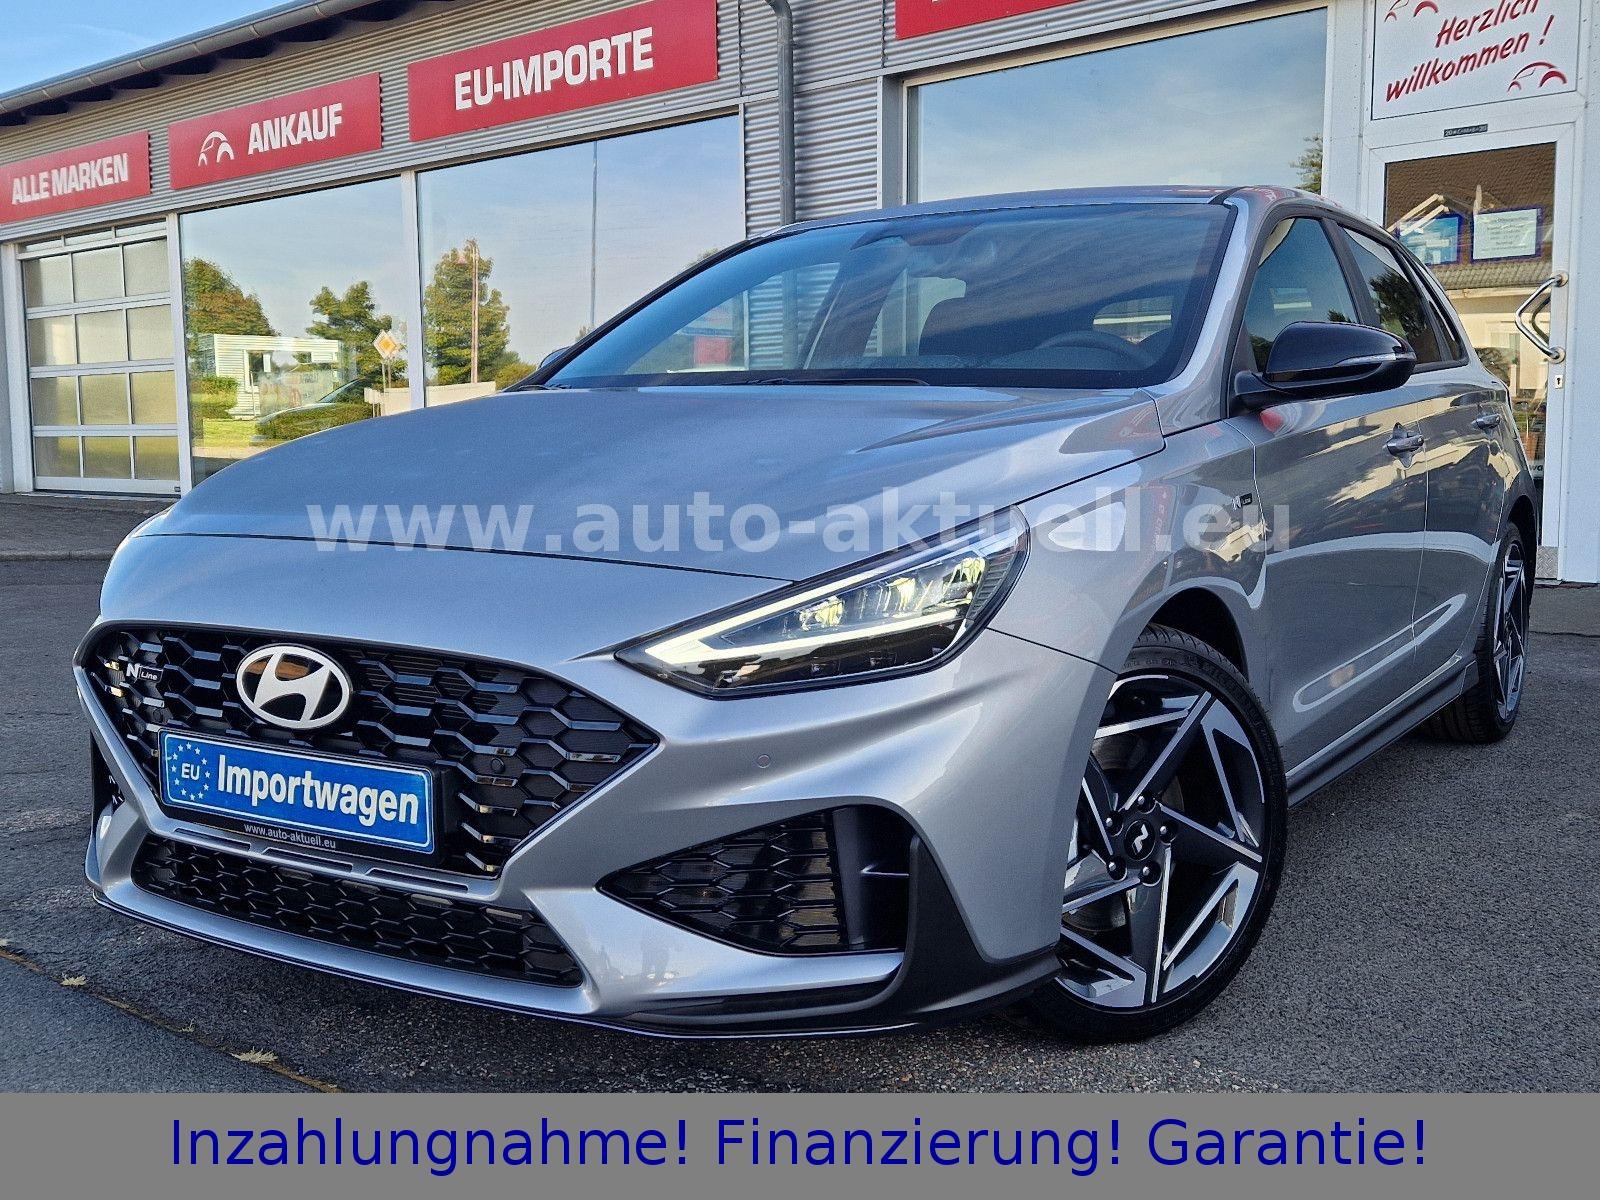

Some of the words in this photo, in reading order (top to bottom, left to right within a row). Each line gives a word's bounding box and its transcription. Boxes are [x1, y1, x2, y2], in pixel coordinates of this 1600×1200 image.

[454, 26, 654, 111] EU-IMPORTE
[1385, 31, 1530, 103] willkommen
[247, 102, 343, 155] ANKAUF
[11, 171, 50, 205] ALLE
[51, 152, 129, 197] MARKEN
[180, 761, 200, 781] EU
[217, 754, 419, 827] Importwagen
[243, 823, 337, 849] www.auto-aktuell.eu
